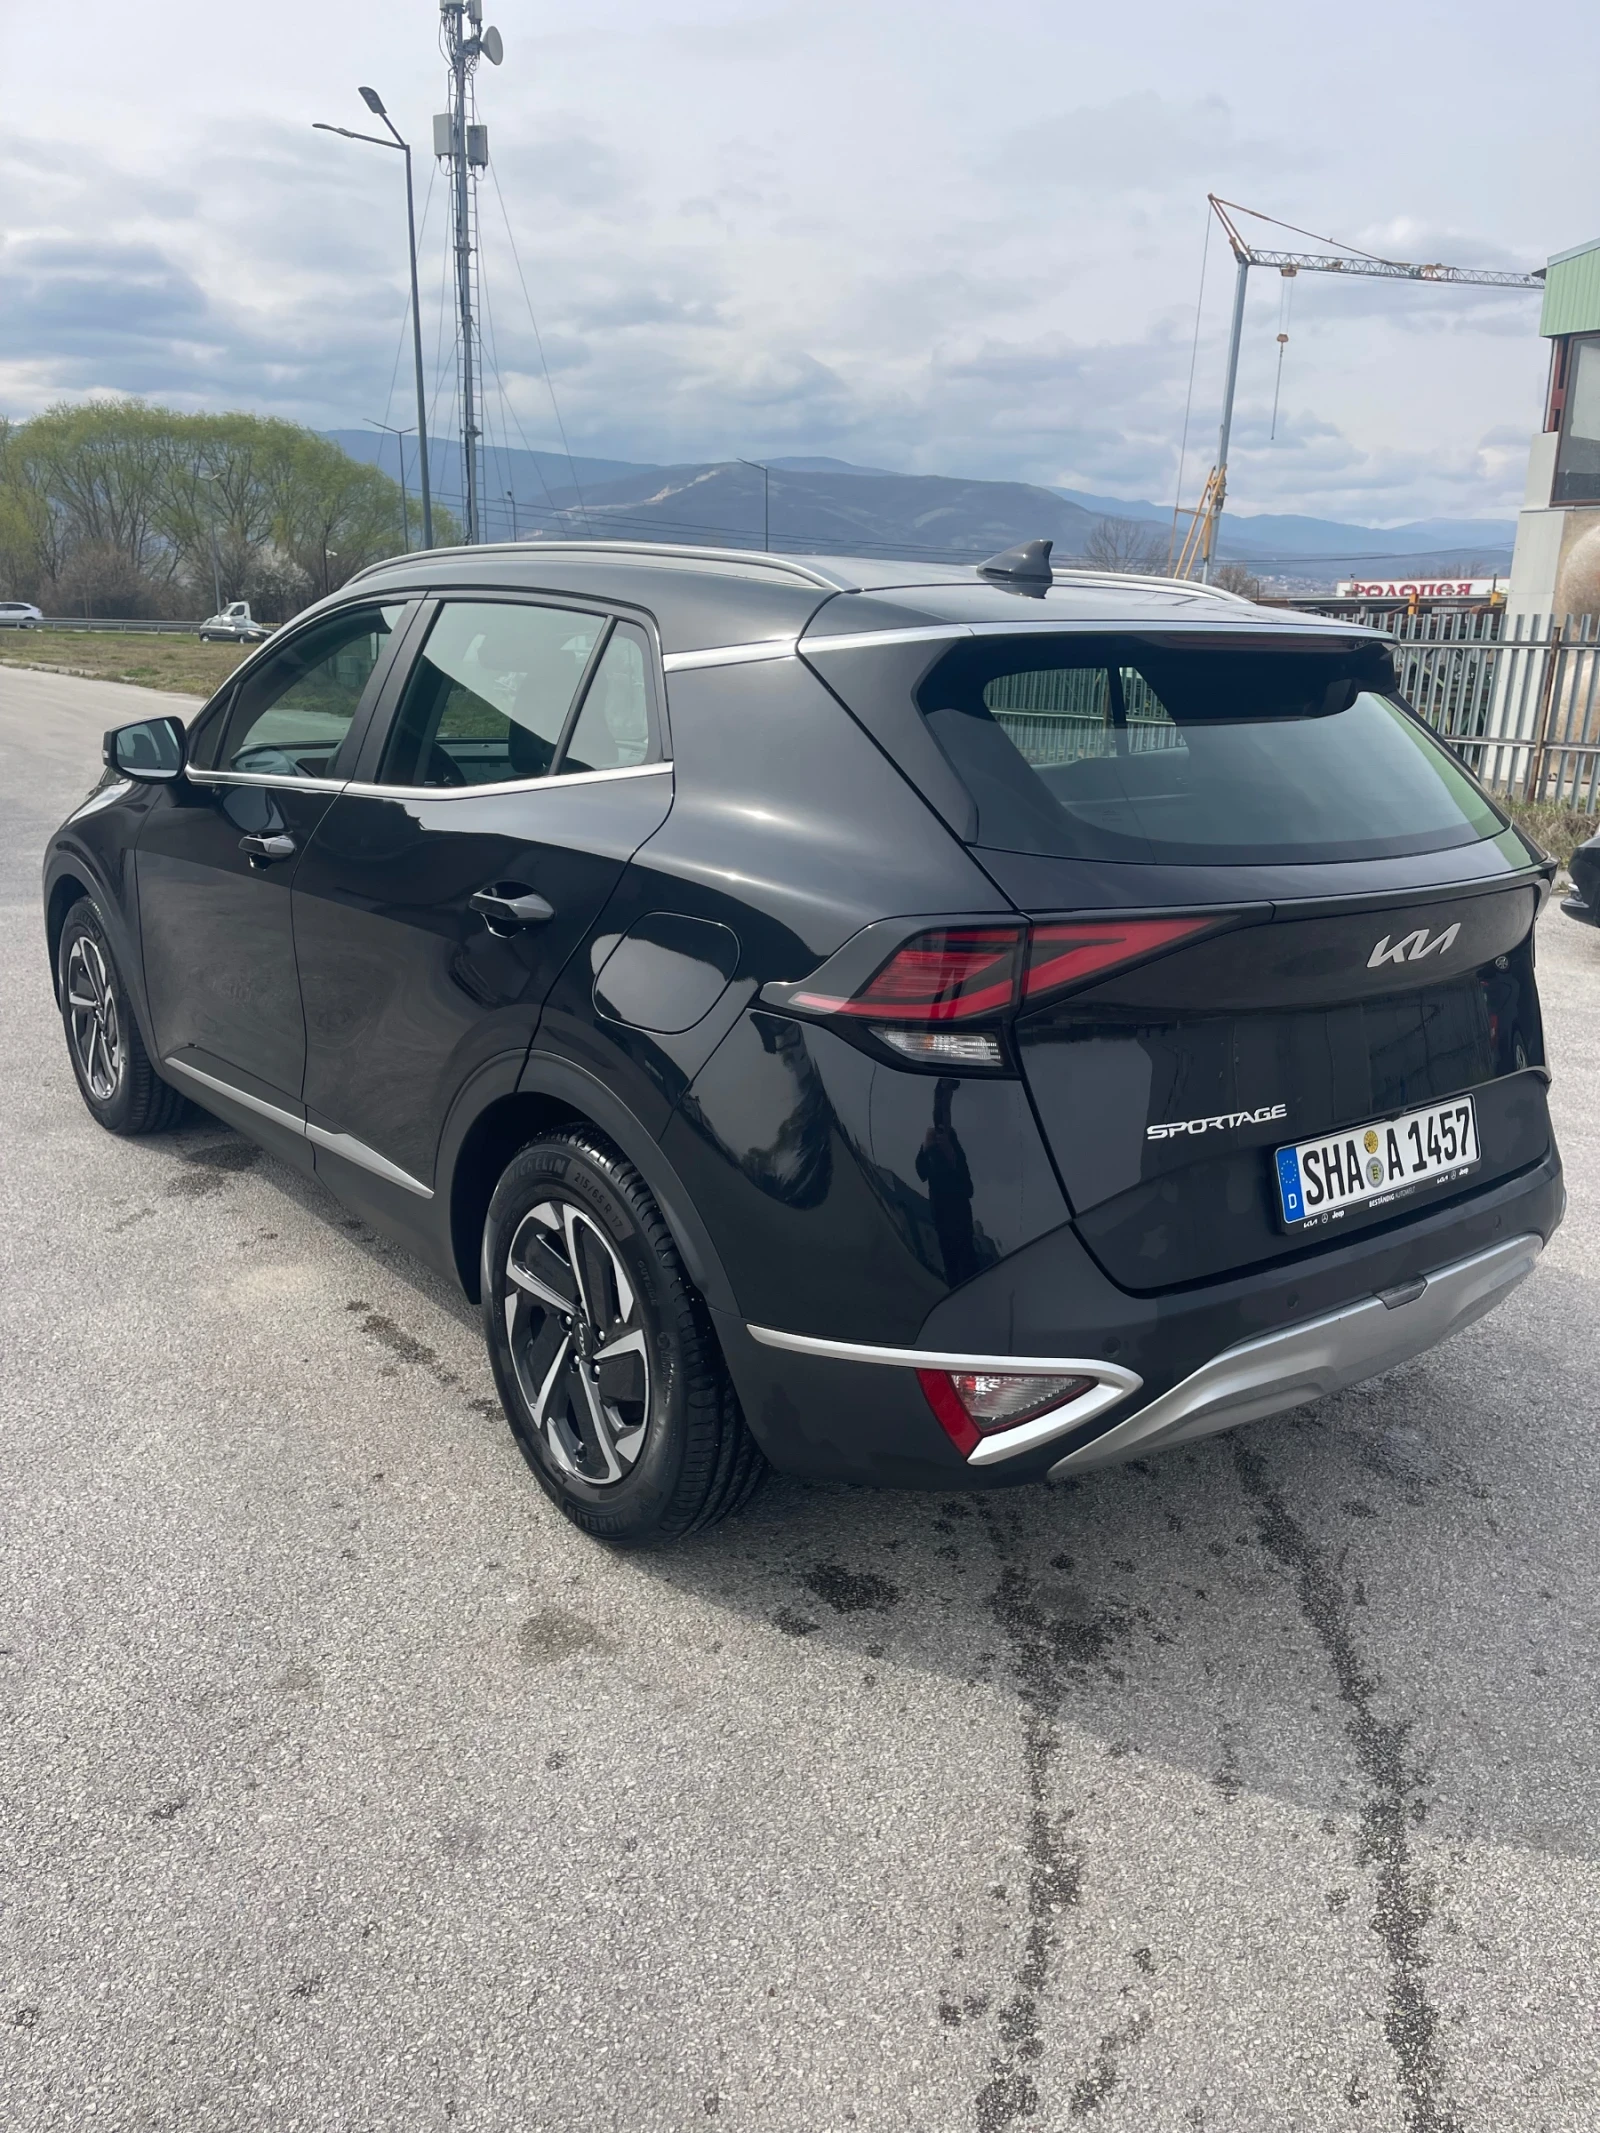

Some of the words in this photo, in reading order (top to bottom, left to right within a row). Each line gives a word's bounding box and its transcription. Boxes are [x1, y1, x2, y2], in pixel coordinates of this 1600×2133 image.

[1366, 922, 1461, 968] KIA
[1147, 1103, 1288, 1140] SPORTAGE
[1302, 1140, 1365, 1206] SHA
[1386, 1128, 1404, 1181] A
[1408, 1106, 1470, 1173] 1457
[506, 1157, 566, 1184] MICHELIN
[574, 1172, 605, 1204] 215/65
[604, 1204, 612, 1215] R
[611, 1216, 624, 1228] 17
[1288, 1193, 1298, 1210] D
[1332, 1209, 1345, 1220] Jeep
